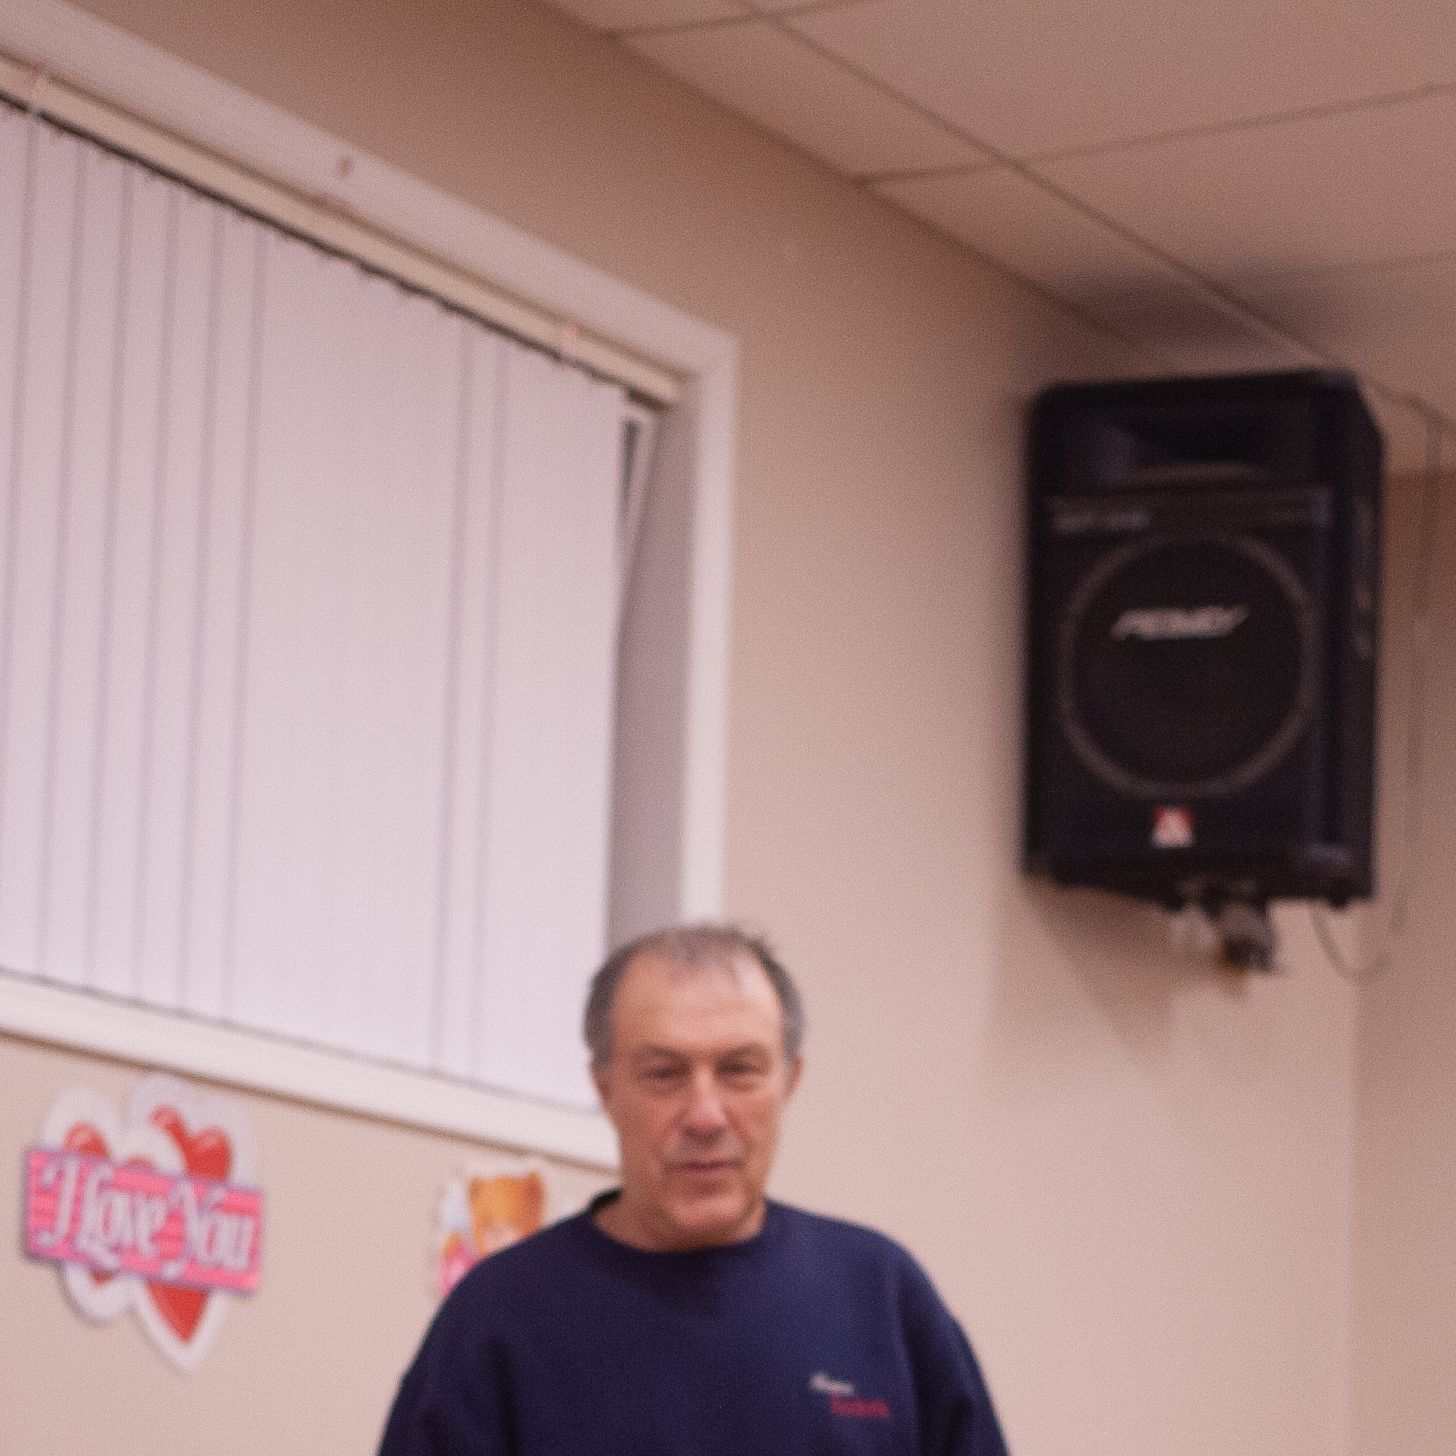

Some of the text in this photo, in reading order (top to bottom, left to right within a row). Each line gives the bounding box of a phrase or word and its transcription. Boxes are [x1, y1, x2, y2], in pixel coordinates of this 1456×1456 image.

[37, 1156, 257, 1280] I Love You
